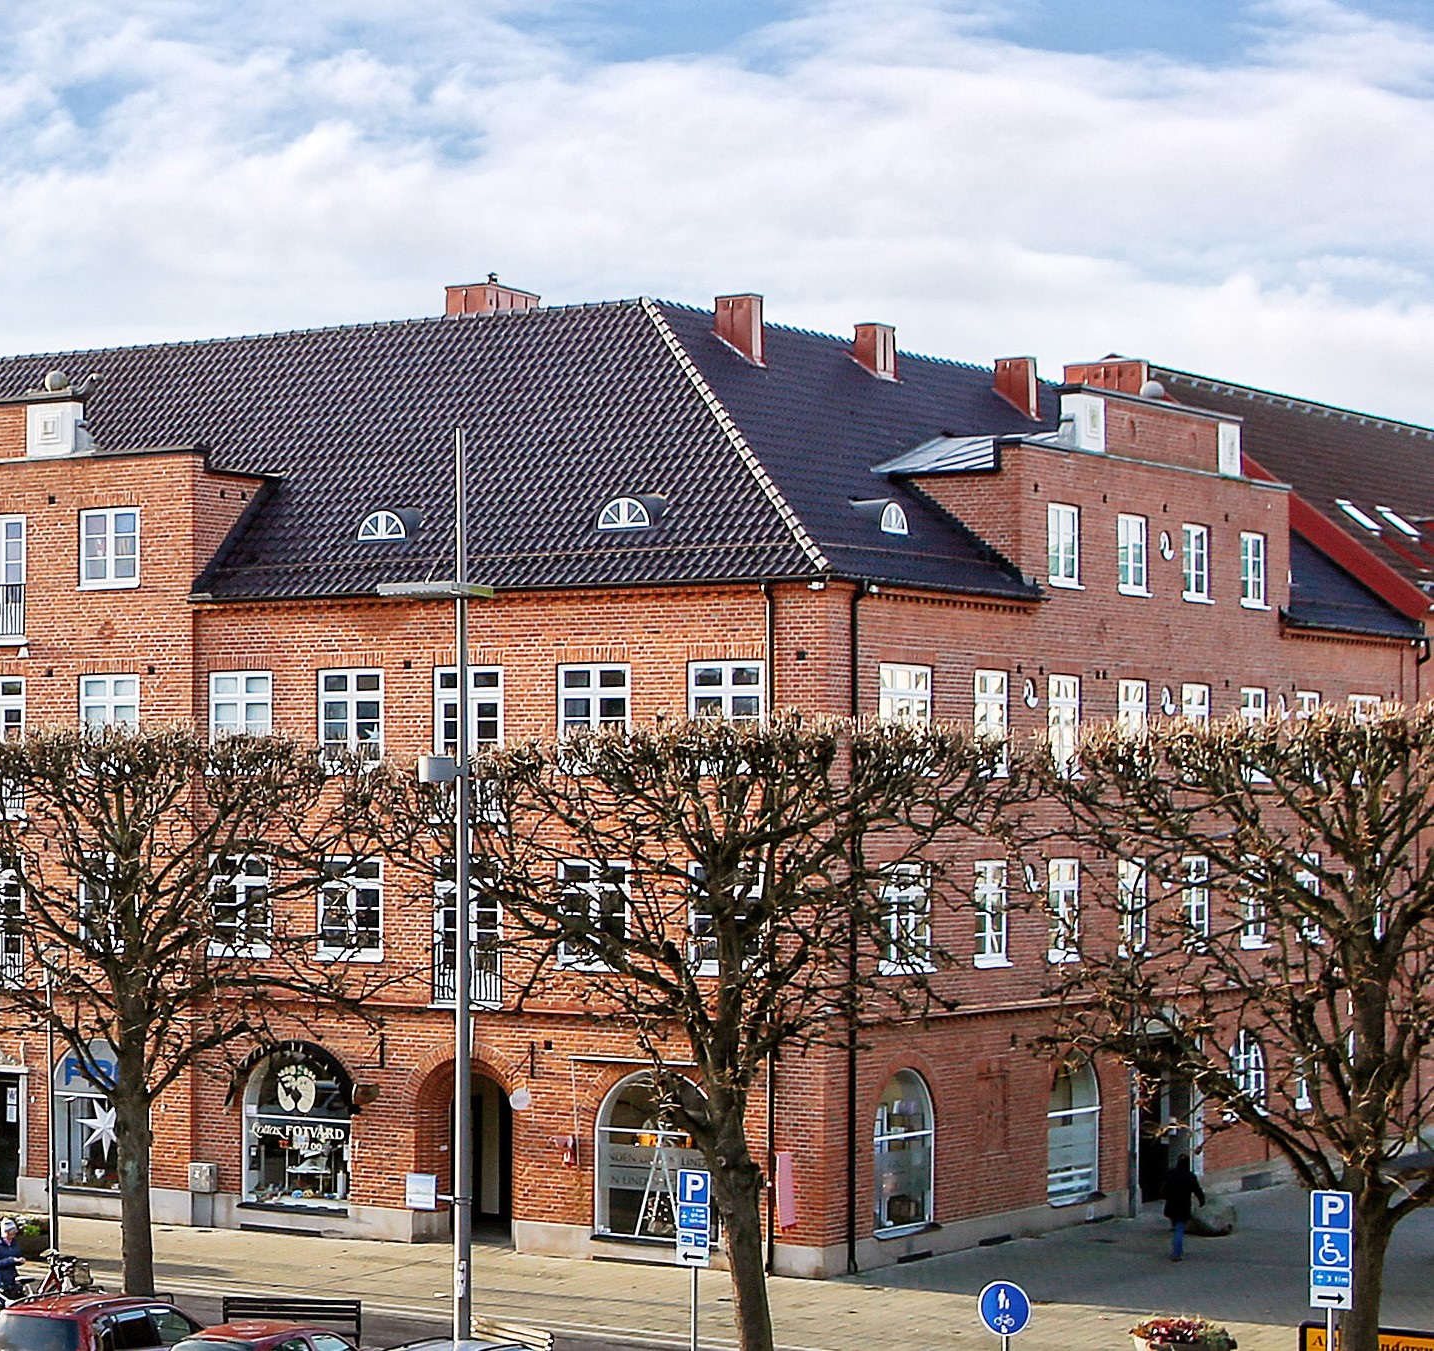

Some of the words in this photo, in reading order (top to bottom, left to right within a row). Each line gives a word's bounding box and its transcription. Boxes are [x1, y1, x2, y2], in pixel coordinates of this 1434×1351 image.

[65, 1057, 120, 1091] PR
[249, 1121, 289, 1140] Lottas
[285, 1124, 345, 1140] FOTVÅRD
[685, 1173, 705, 1201] P
[1322, 1195, 1345, 1226] P
